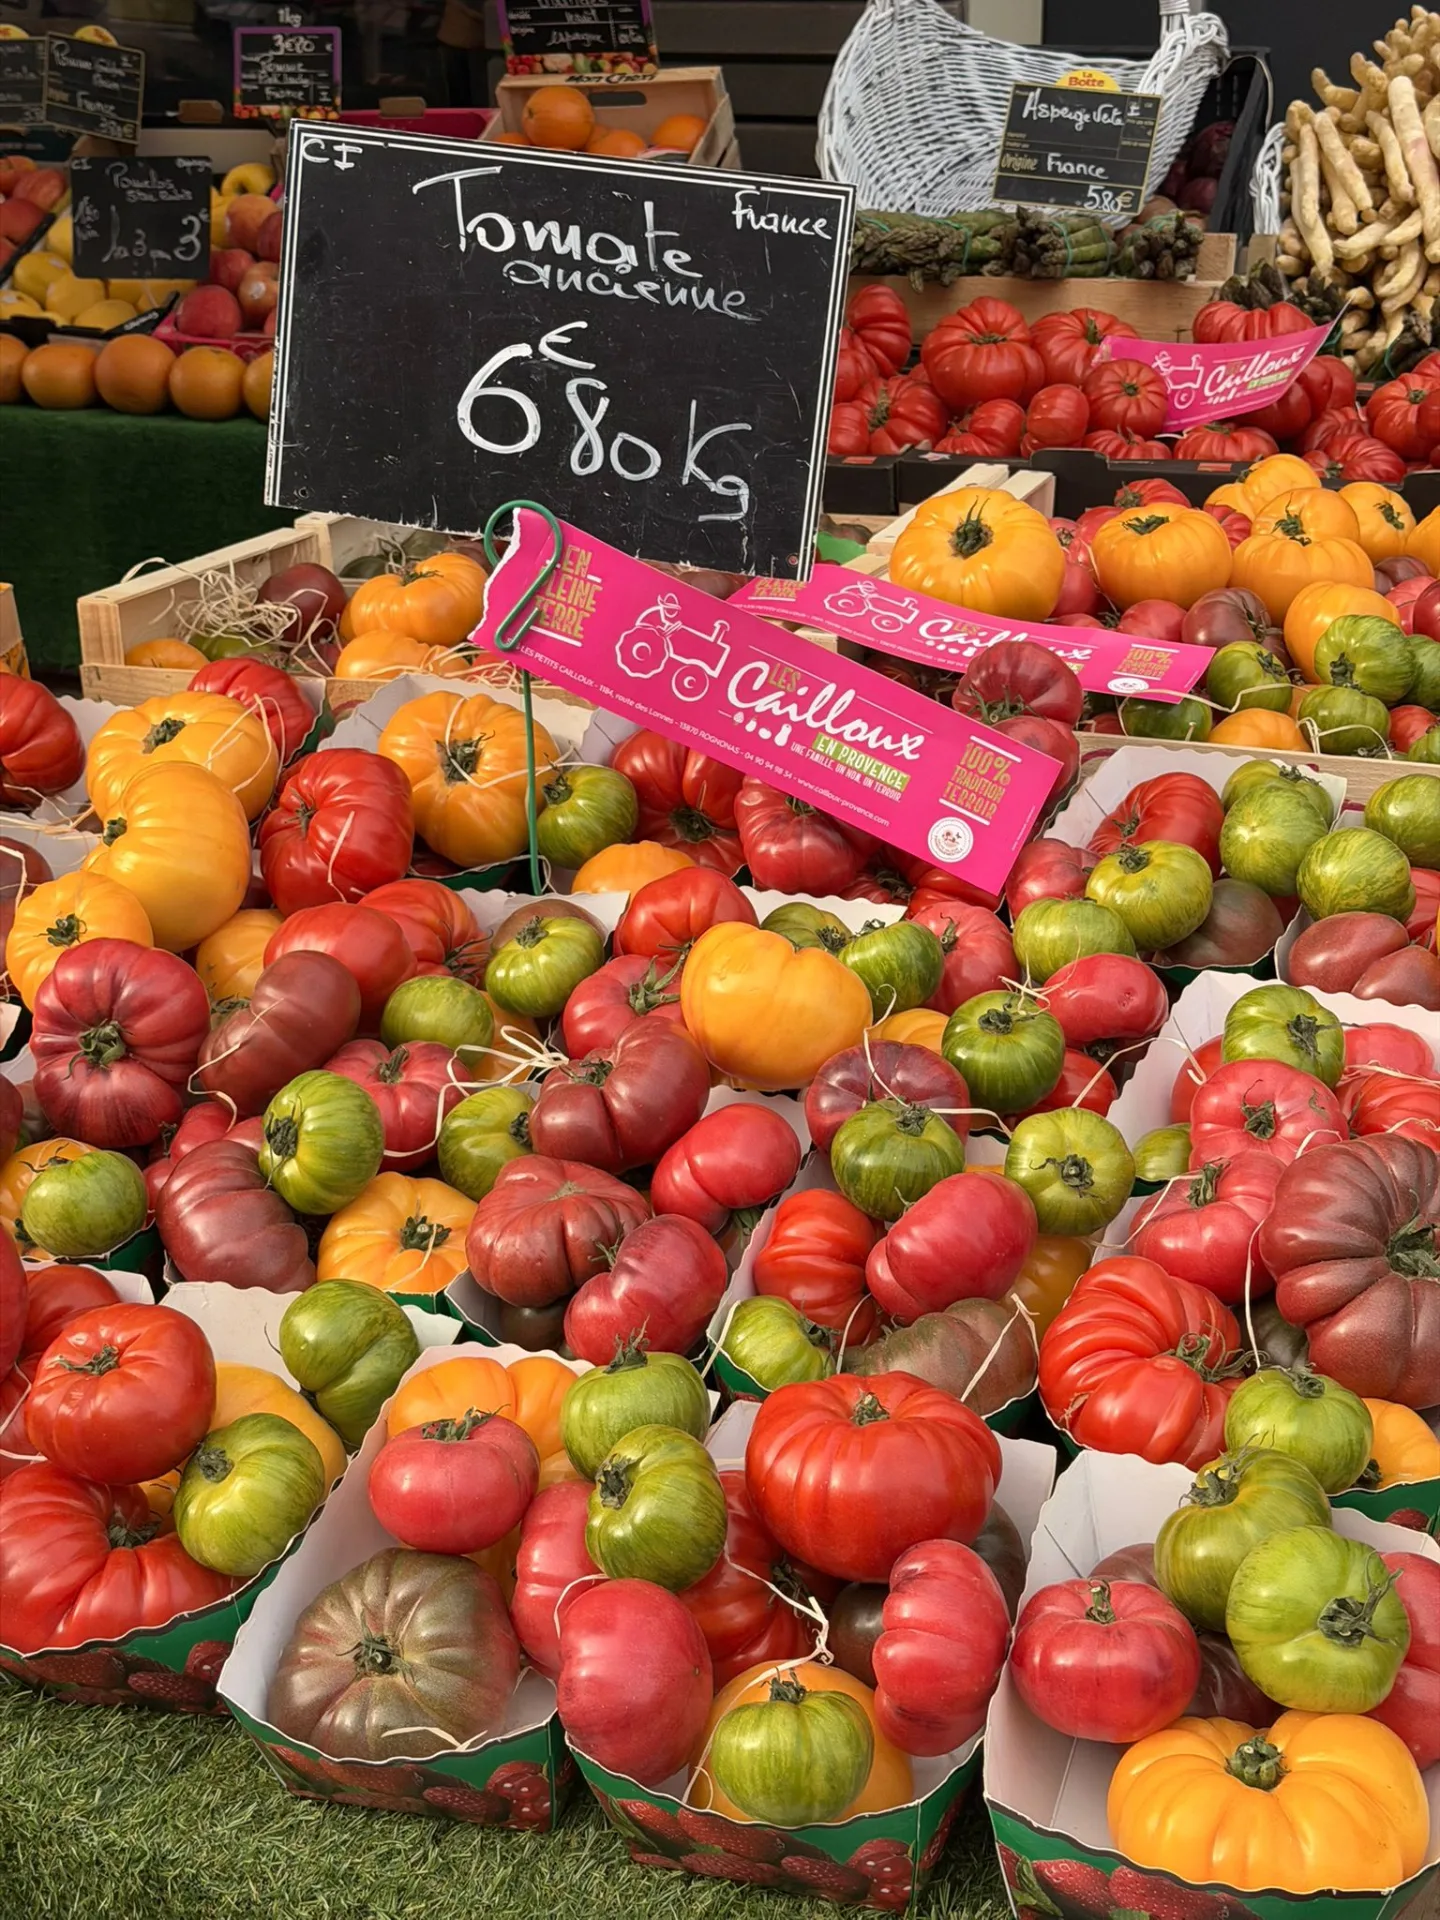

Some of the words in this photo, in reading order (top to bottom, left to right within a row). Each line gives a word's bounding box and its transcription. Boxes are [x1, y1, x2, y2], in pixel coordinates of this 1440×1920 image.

[1068, 77, 1105, 87] Botte
[1000, 152, 1039, 172] Origine
[1047, 152, 1109, 180] France
[414, 165, 703, 278] Tomate
[732, 189, 833, 240] France
[503, 258, 762, 322] ancienne
[1203, 345, 1306, 398] Cailloux
[561, 544, 592, 578] EN
[767, 663, 802, 693] LES
[1126, 647, 1174, 665] 100%
[520, 645, 535, 659] LES
[534, 651, 560, 670] PETITS
[558, 664, 595, 688] CAILLOUX
[615, 693, 635, 708] route
[635, 702, 649, 713] des
[699, 730, 741, 755] ROGNONAS
[744, 752, 754, 761] 04
[726, 660, 926, 761] Cailloux
[790, 741, 805, 756] UNE
[834, 763, 846, 774] UN
[862, 776, 875, 789] UN
[817, 736, 838, 757] EN
[838, 744, 909, 791] PROVENCE
[950, 764, 1007, 805] TRADITION
[960, 742, 1013, 787] 100%
[942, 780, 998, 821] TERROIR
